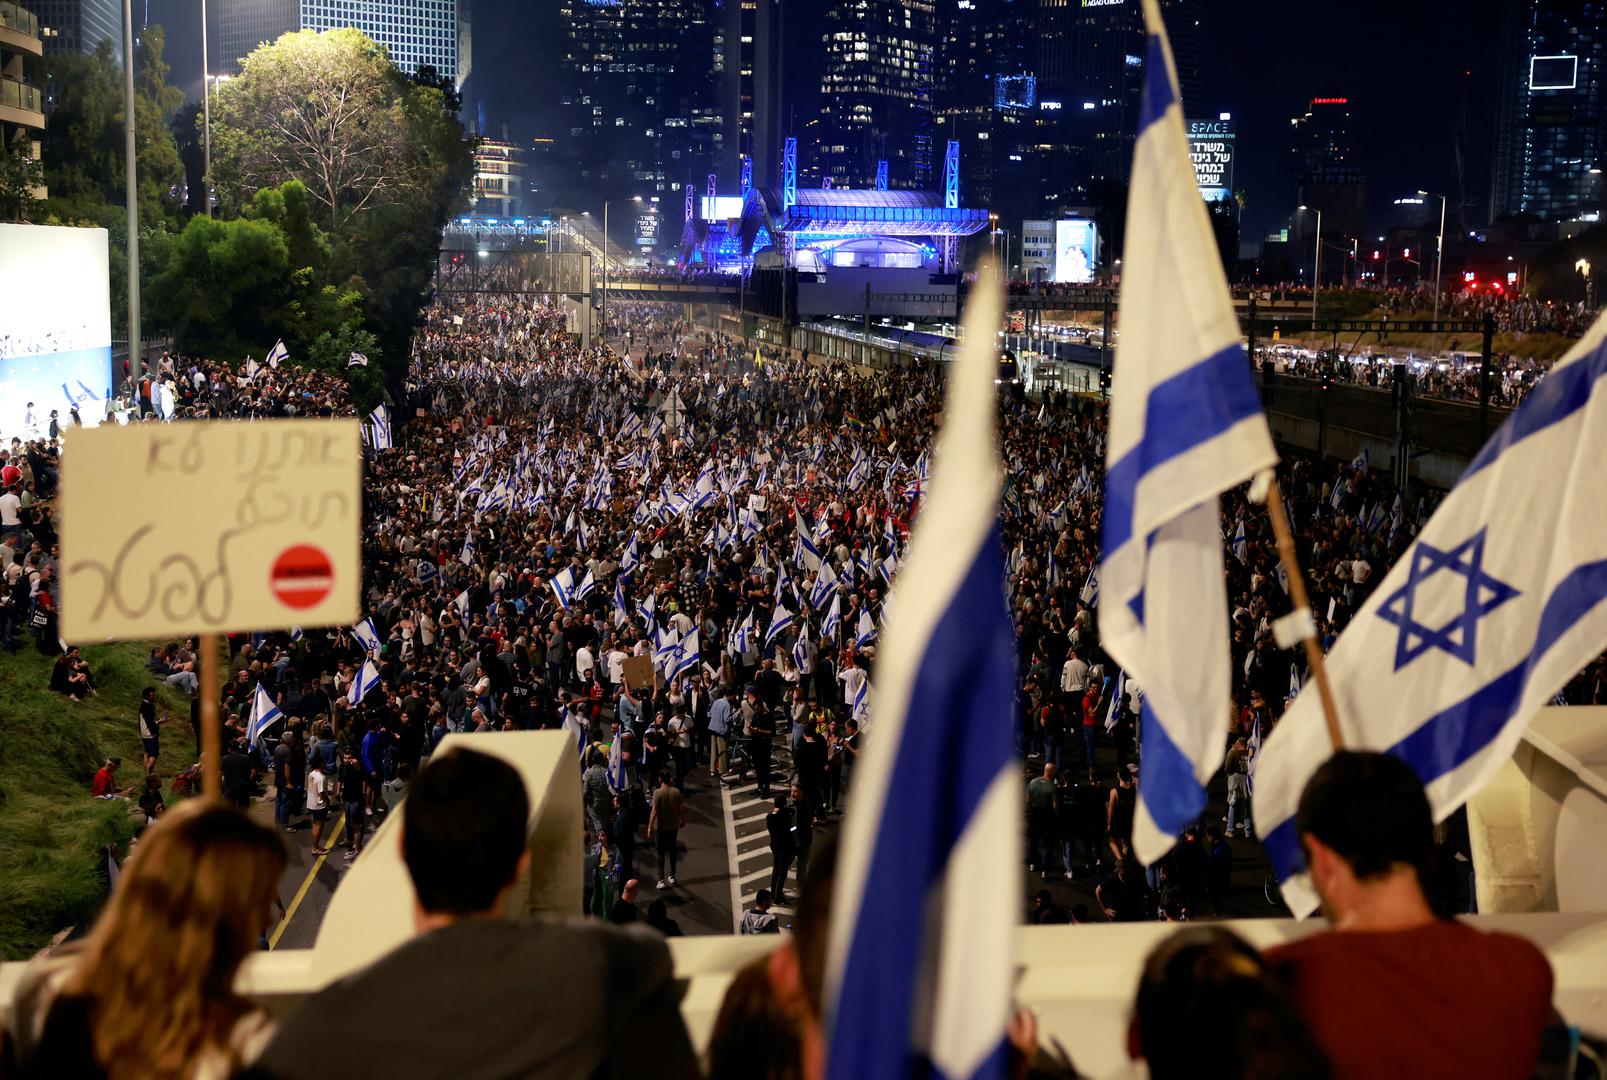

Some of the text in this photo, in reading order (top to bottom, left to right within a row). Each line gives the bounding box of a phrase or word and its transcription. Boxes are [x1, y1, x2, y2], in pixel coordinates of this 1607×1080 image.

[1191, 123, 1228, 132] SPACE
[1194, 142, 1224, 152] משרד
[1214, 152, 1230, 162] של
[1193, 163, 1224, 172] במחיר
[1196, 174, 1219, 183] שפוי
[146, 423, 349, 479] אותנו לא
[237, 476, 349, 530] תוכל
[68, 524, 242, 625] לפטר
